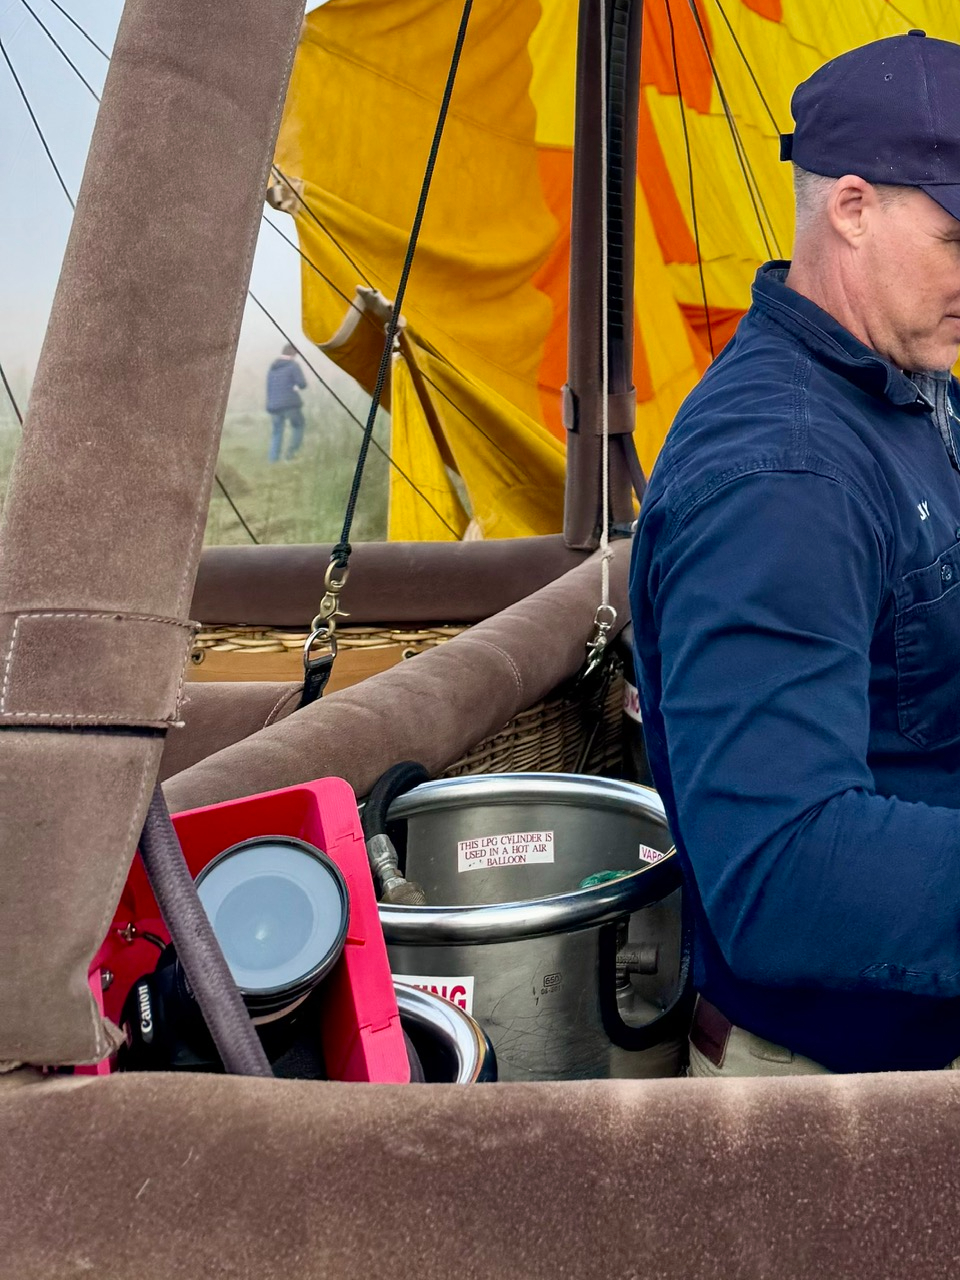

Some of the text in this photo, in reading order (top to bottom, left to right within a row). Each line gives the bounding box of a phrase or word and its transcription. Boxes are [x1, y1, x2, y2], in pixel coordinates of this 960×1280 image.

[460, 833, 553, 851] THIS LPG CYLINDER IS
[465, 844, 547, 860] USED IN A HOT AIR
[487, 855, 527, 867] BALLOON
[138, 984, 153, 1033] Canon
